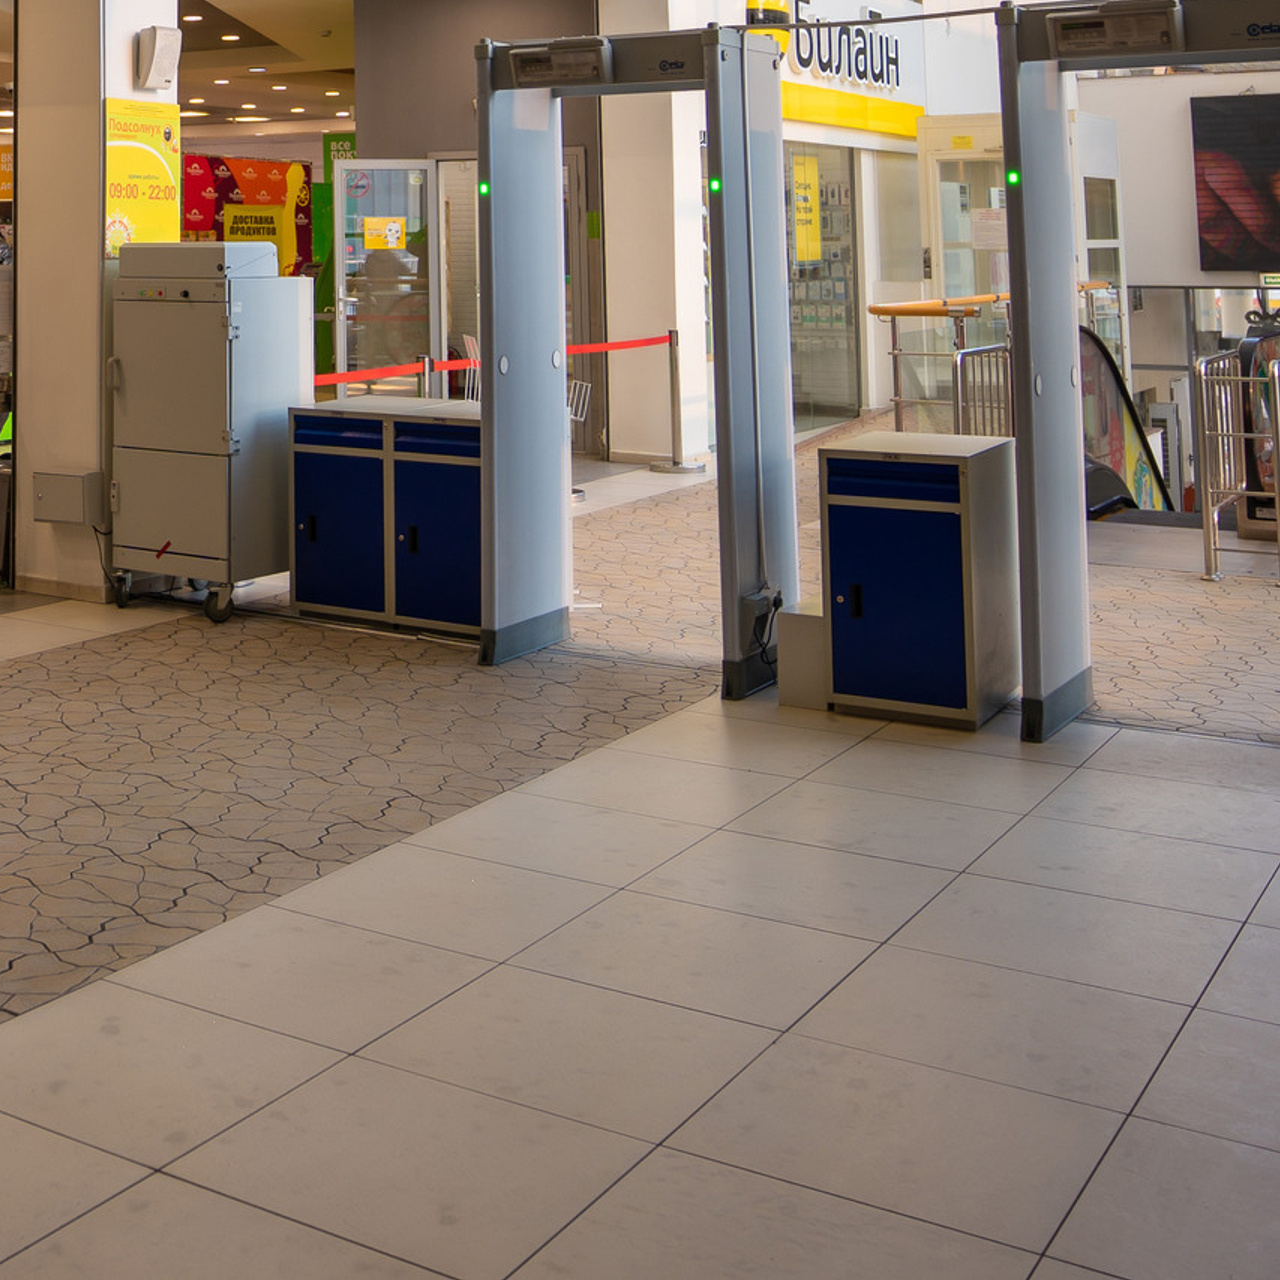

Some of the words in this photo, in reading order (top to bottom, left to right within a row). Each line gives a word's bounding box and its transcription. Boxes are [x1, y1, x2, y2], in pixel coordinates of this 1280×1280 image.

[108, 118, 161, 136] Подсолнух
[109, 183, 139, 199] 09:00
[148, 184, 177, 201] 22:00
[232, 215, 275, 226] ДОСТАВКА
[229, 226, 277, 237] ПРОДУКТОВ
